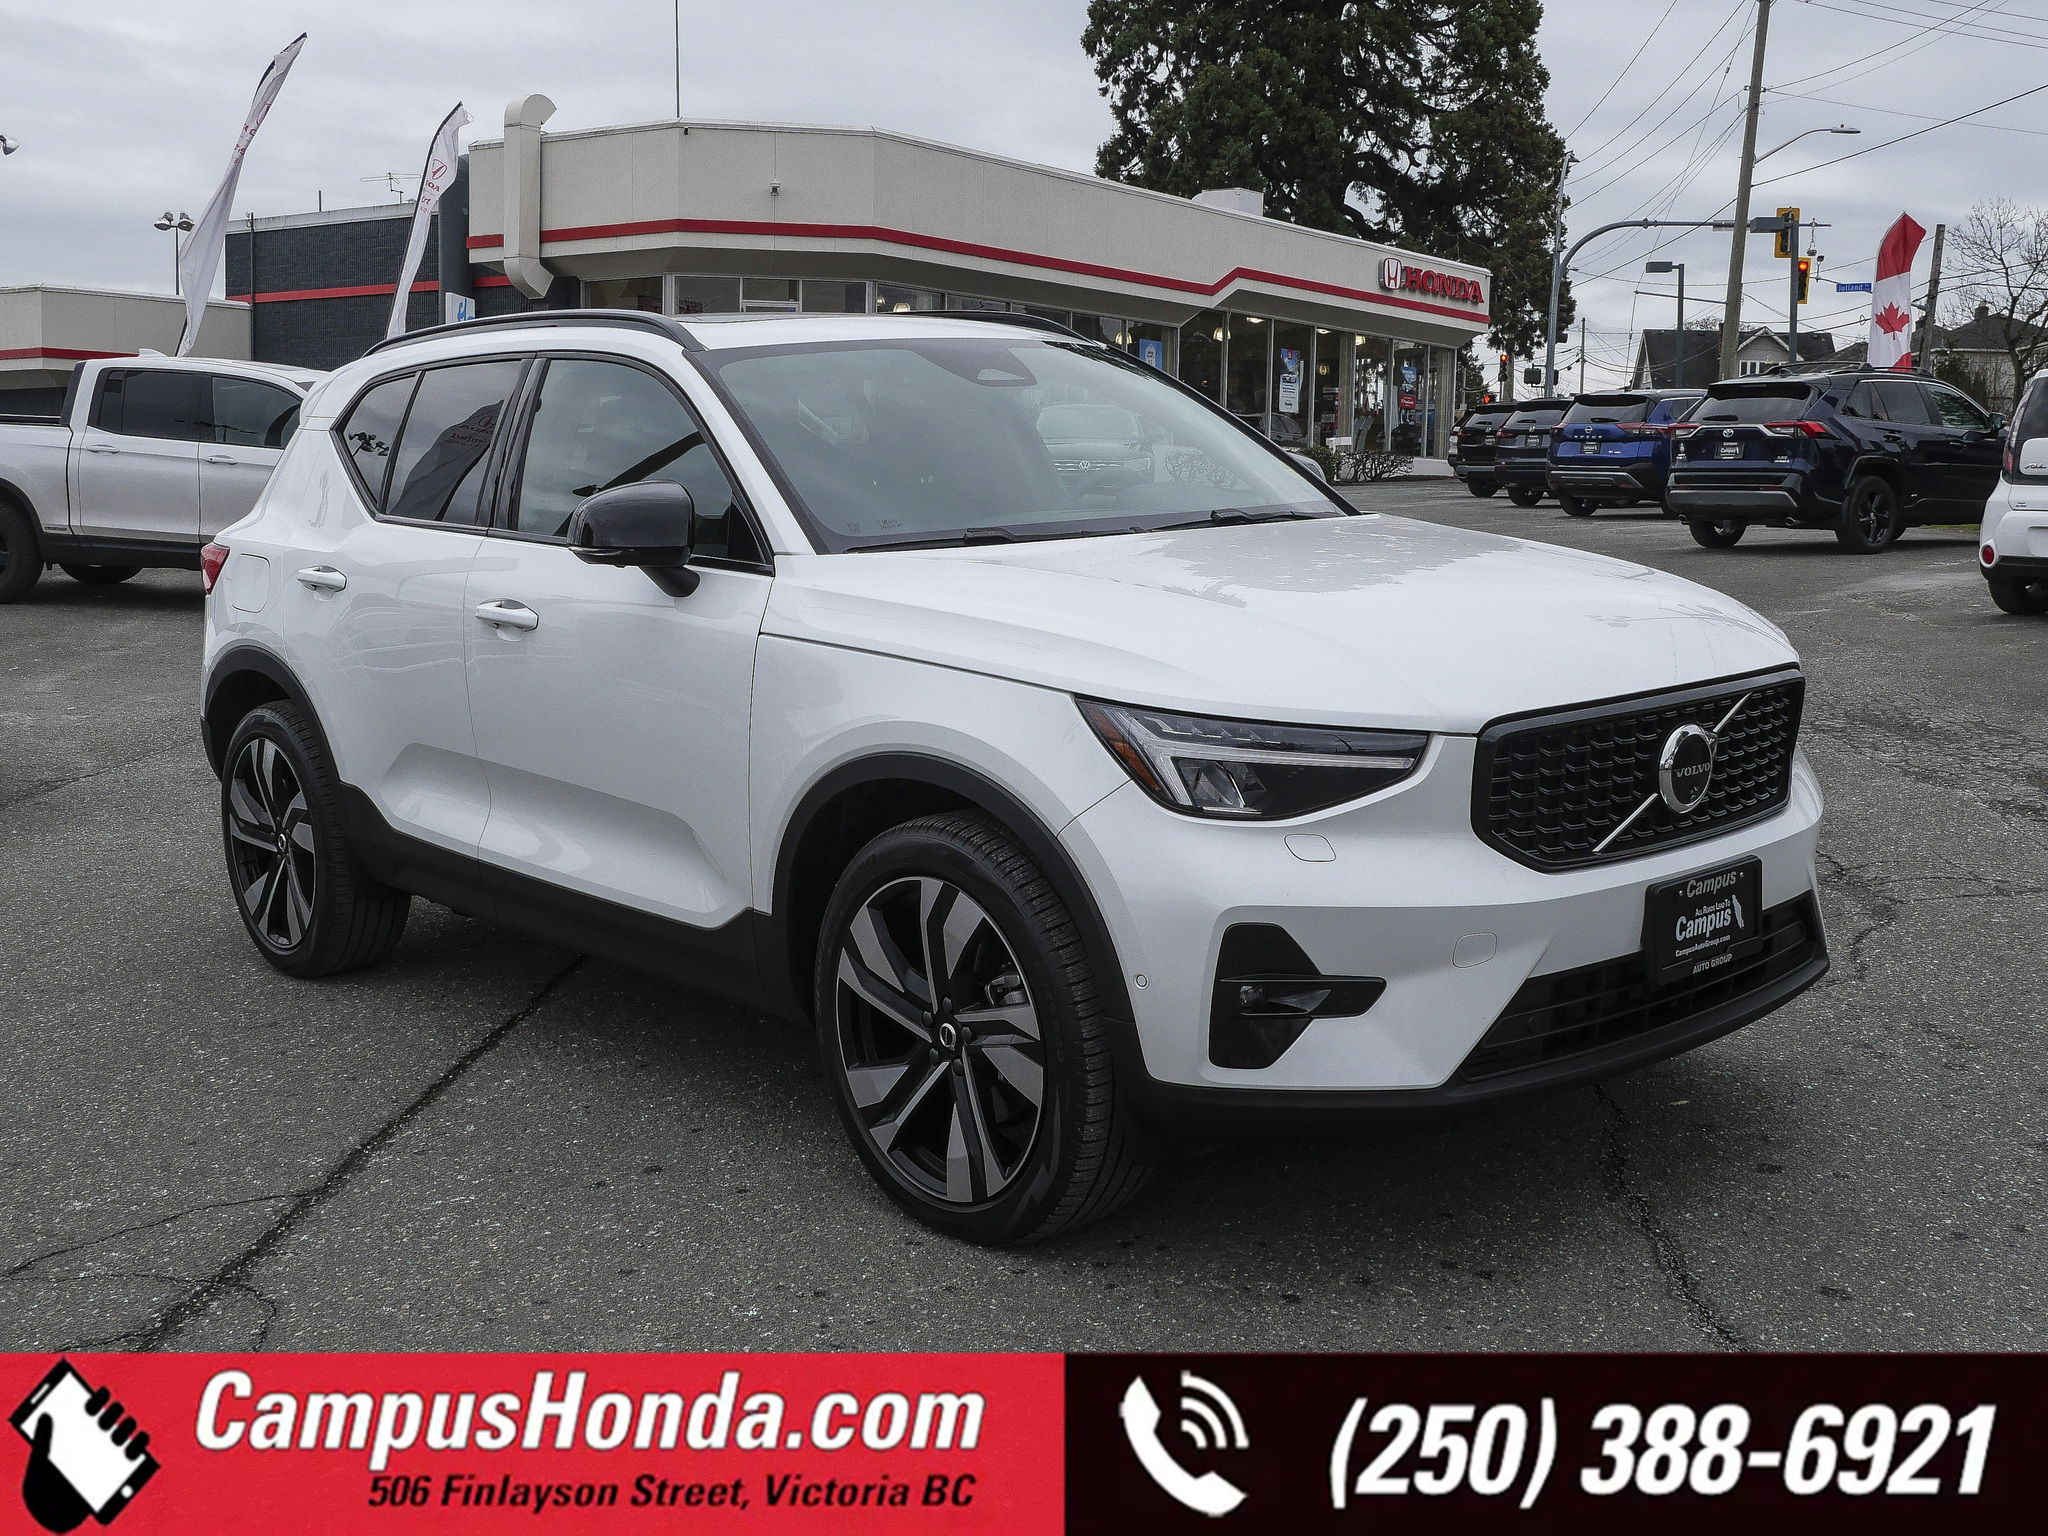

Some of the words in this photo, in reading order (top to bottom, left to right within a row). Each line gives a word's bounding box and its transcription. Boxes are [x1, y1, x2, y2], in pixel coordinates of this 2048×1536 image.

[1404, 265, 1484, 304] HONDA
[1674, 762, 1711, 778] VOLVO
[1686, 871, 1737, 898] Campus
[1675, 908, 1732, 941] Campus
[1675, 935, 1731, 957] CampusAutoGroup.com
[1692, 961, 1710, 974] AUTO
[1710, 953, 1733, 968] GROUP
